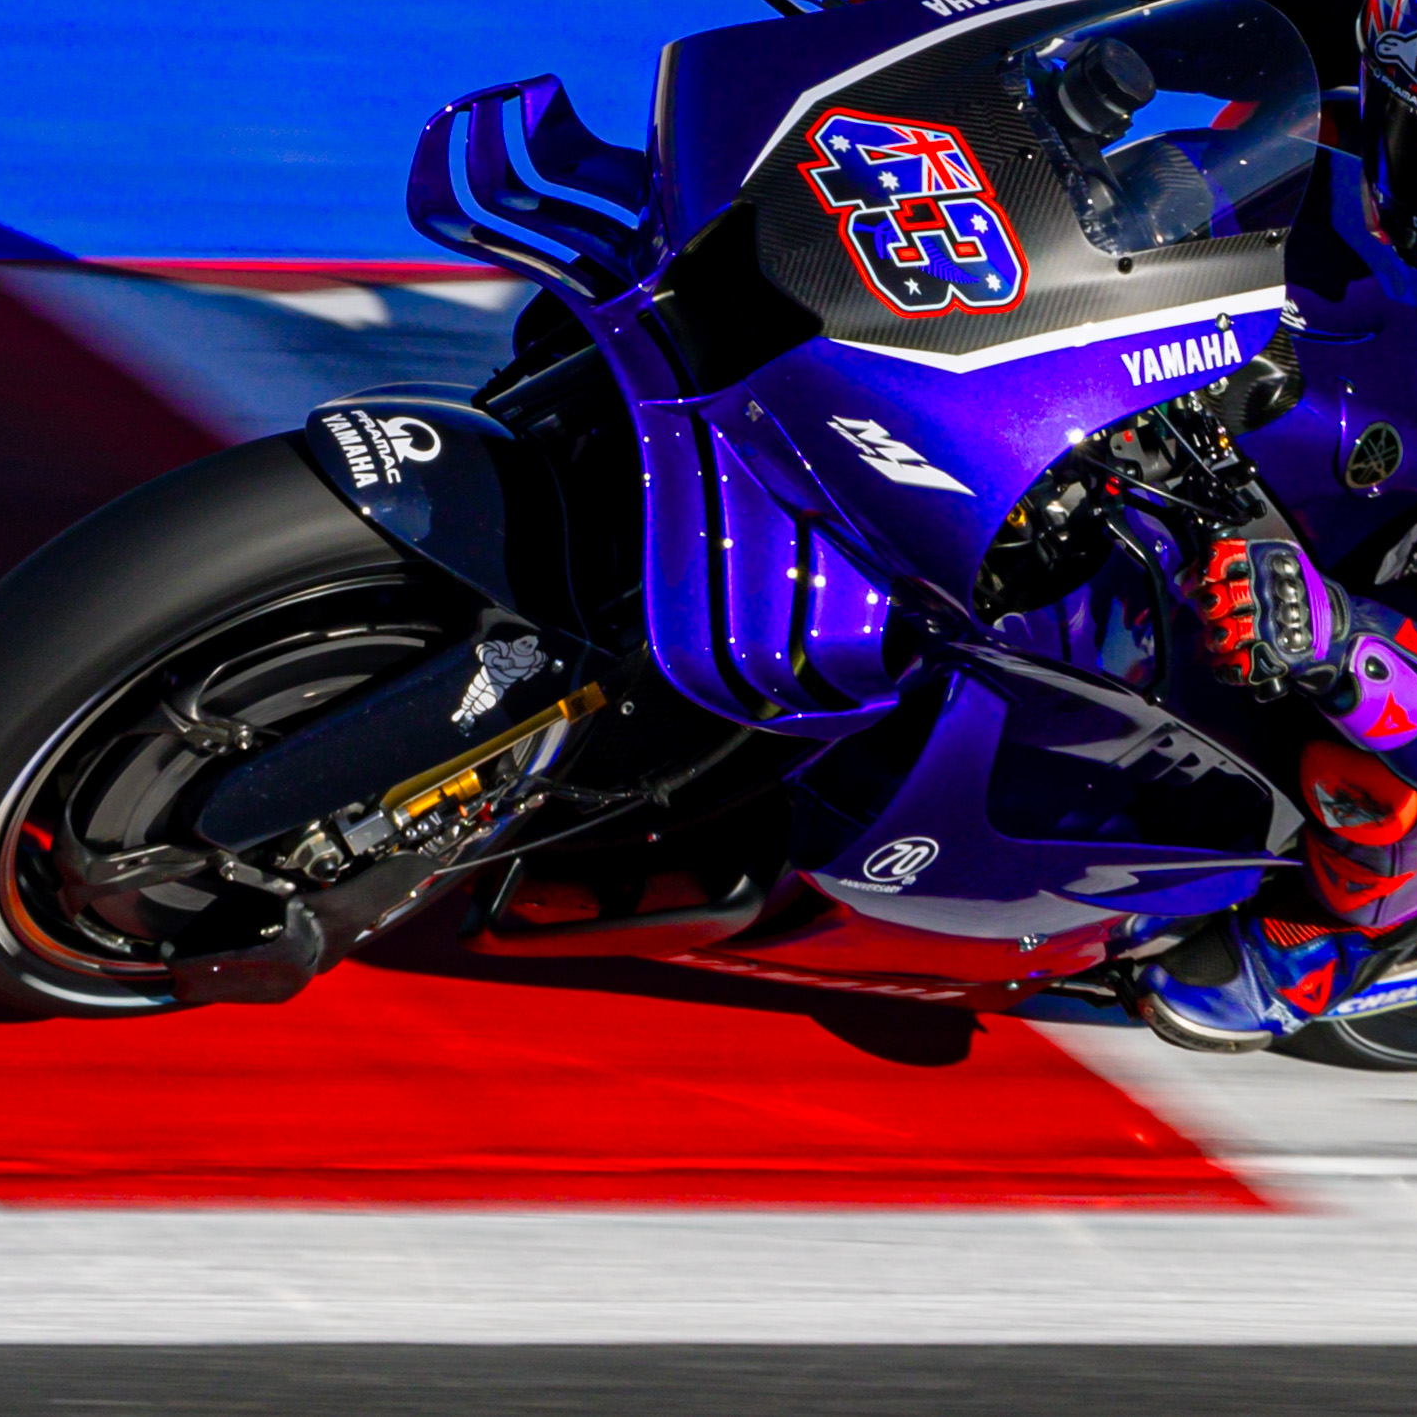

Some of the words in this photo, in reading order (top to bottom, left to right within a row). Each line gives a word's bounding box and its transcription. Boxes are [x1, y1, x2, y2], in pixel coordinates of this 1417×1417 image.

[797, 107, 1030, 319] 43
[1121, 330, 1243, 387] YAMAHA
[322, 413, 379, 489] YAMAHA
[351, 409, 402, 484] PRAMAC
[870, 843, 930, 876] 70
